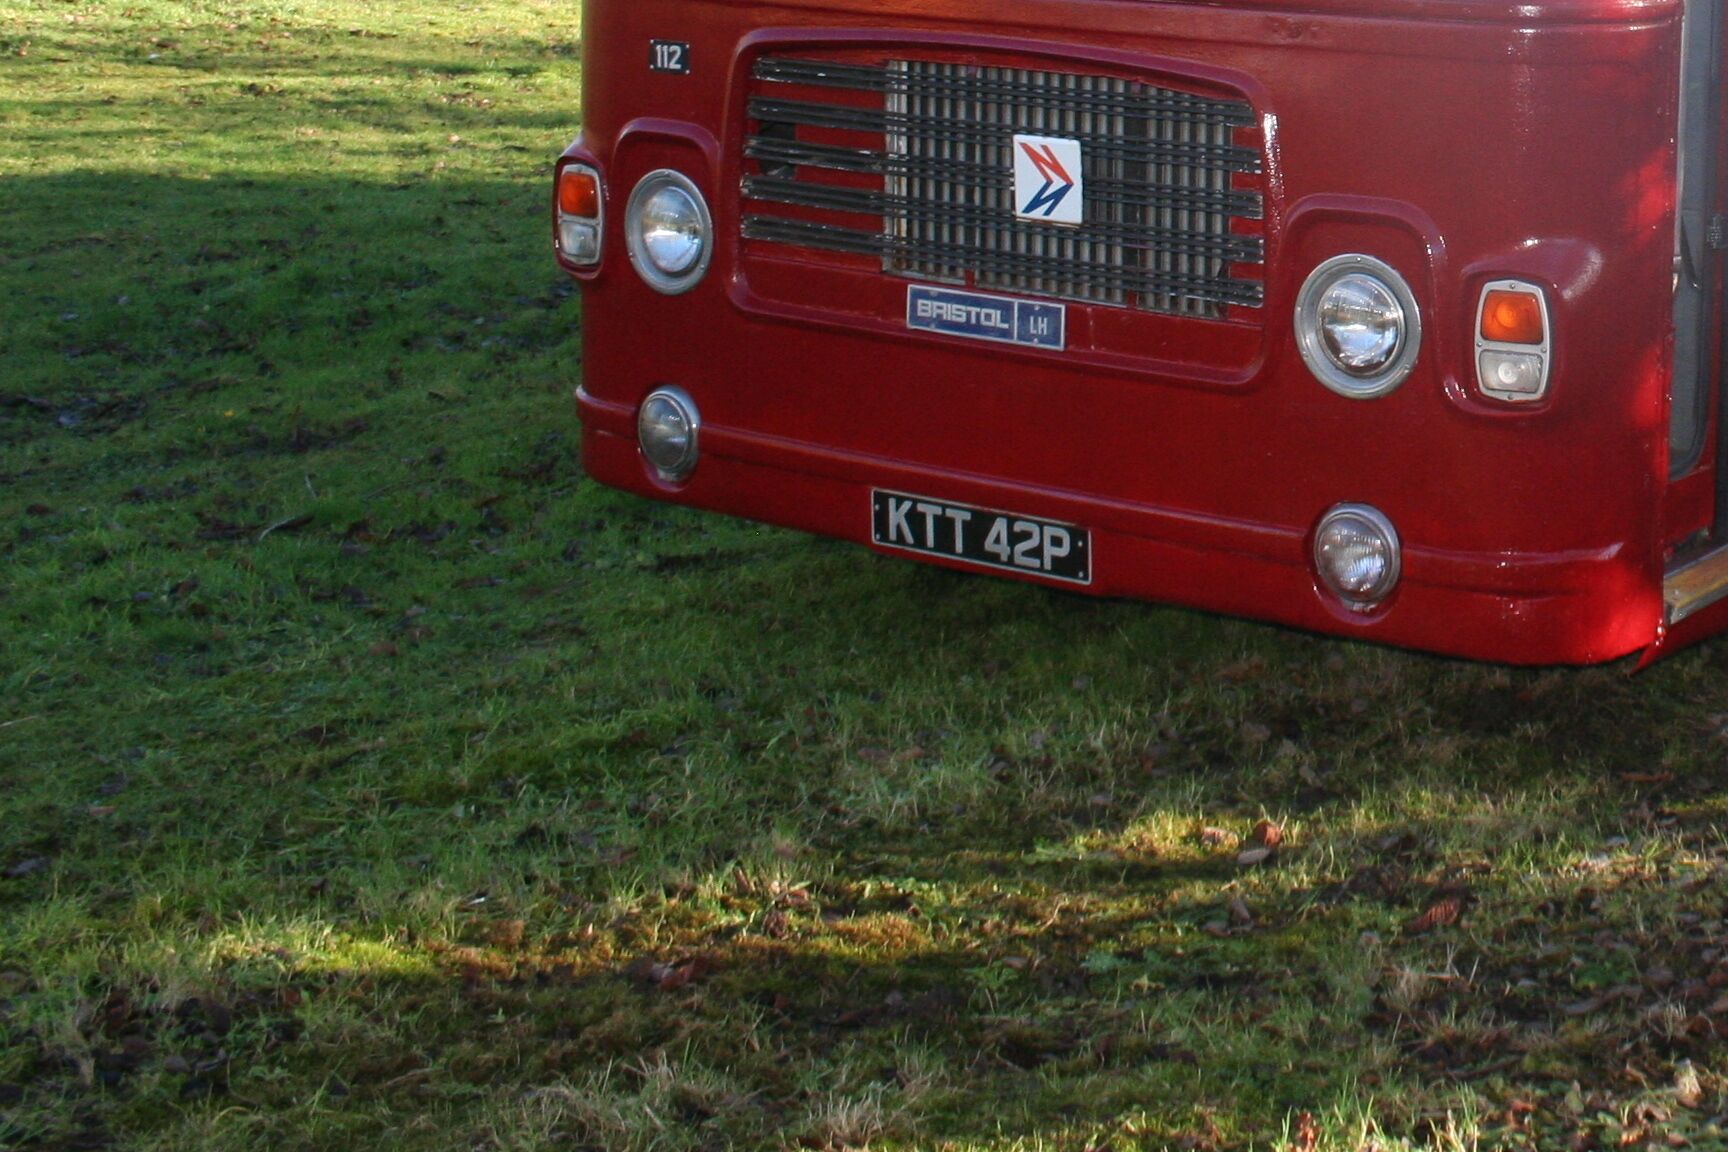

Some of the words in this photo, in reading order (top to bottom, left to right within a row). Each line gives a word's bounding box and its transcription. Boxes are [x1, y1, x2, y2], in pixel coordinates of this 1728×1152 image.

[655, 44, 682, 69] 112
[917, 300, 1009, 329] BRISTOL
[1030, 316, 1047, 335] LH
[888, 497, 972, 554] KTT
[984, 517, 1071, 570] 42P
